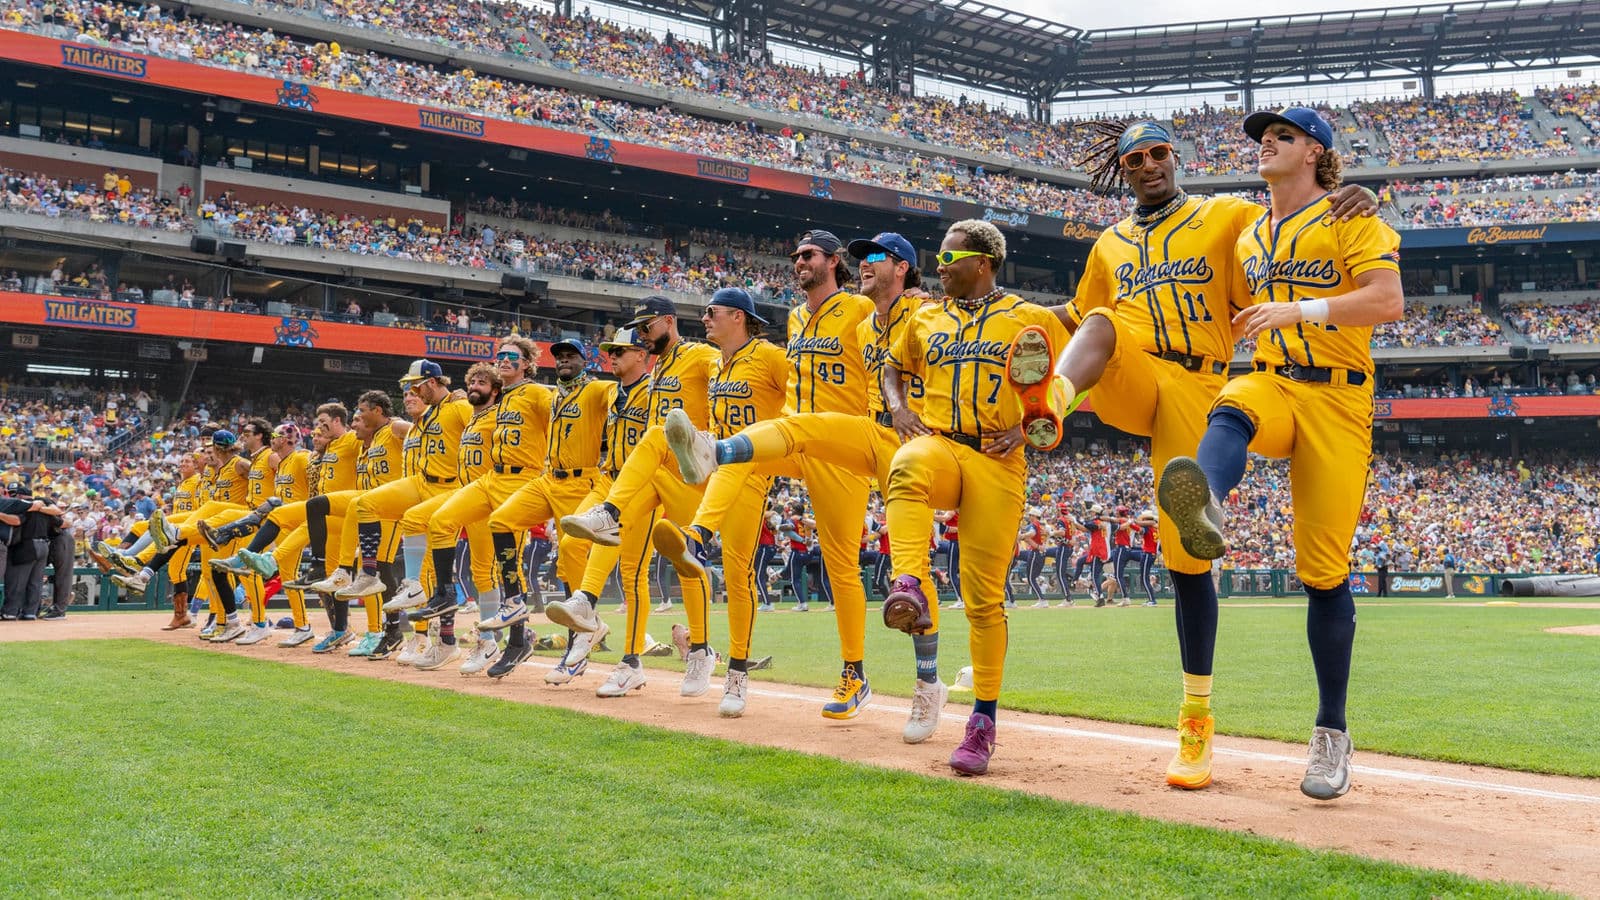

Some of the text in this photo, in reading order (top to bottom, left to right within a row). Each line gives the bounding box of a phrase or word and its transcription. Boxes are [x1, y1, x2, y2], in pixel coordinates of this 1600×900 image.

[63, 46, 144, 75] TAILGATERS
[421, 111, 482, 133] TAILGATERS
[698, 160, 748, 180] TAILGATERS
[899, 195, 941, 213] TAILGATERS
[1467, 226, 1547, 244] Go Bananas!
[1115, 256, 1214, 299] Bananas
[48, 302, 133, 325] TAILGATERS
[1183, 291, 1212, 321] 11
[428, 337, 491, 357] TAILGATERS
[817, 362, 846, 386] 49
[987, 373, 1003, 405] 7
[729, 405, 756, 426] 20
[428, 439, 446, 455] 24
[503, 429, 521, 446] 13
[375, 459, 389, 474] 18
[466, 449, 483, 466] 10
[327, 467, 334, 479] 3
